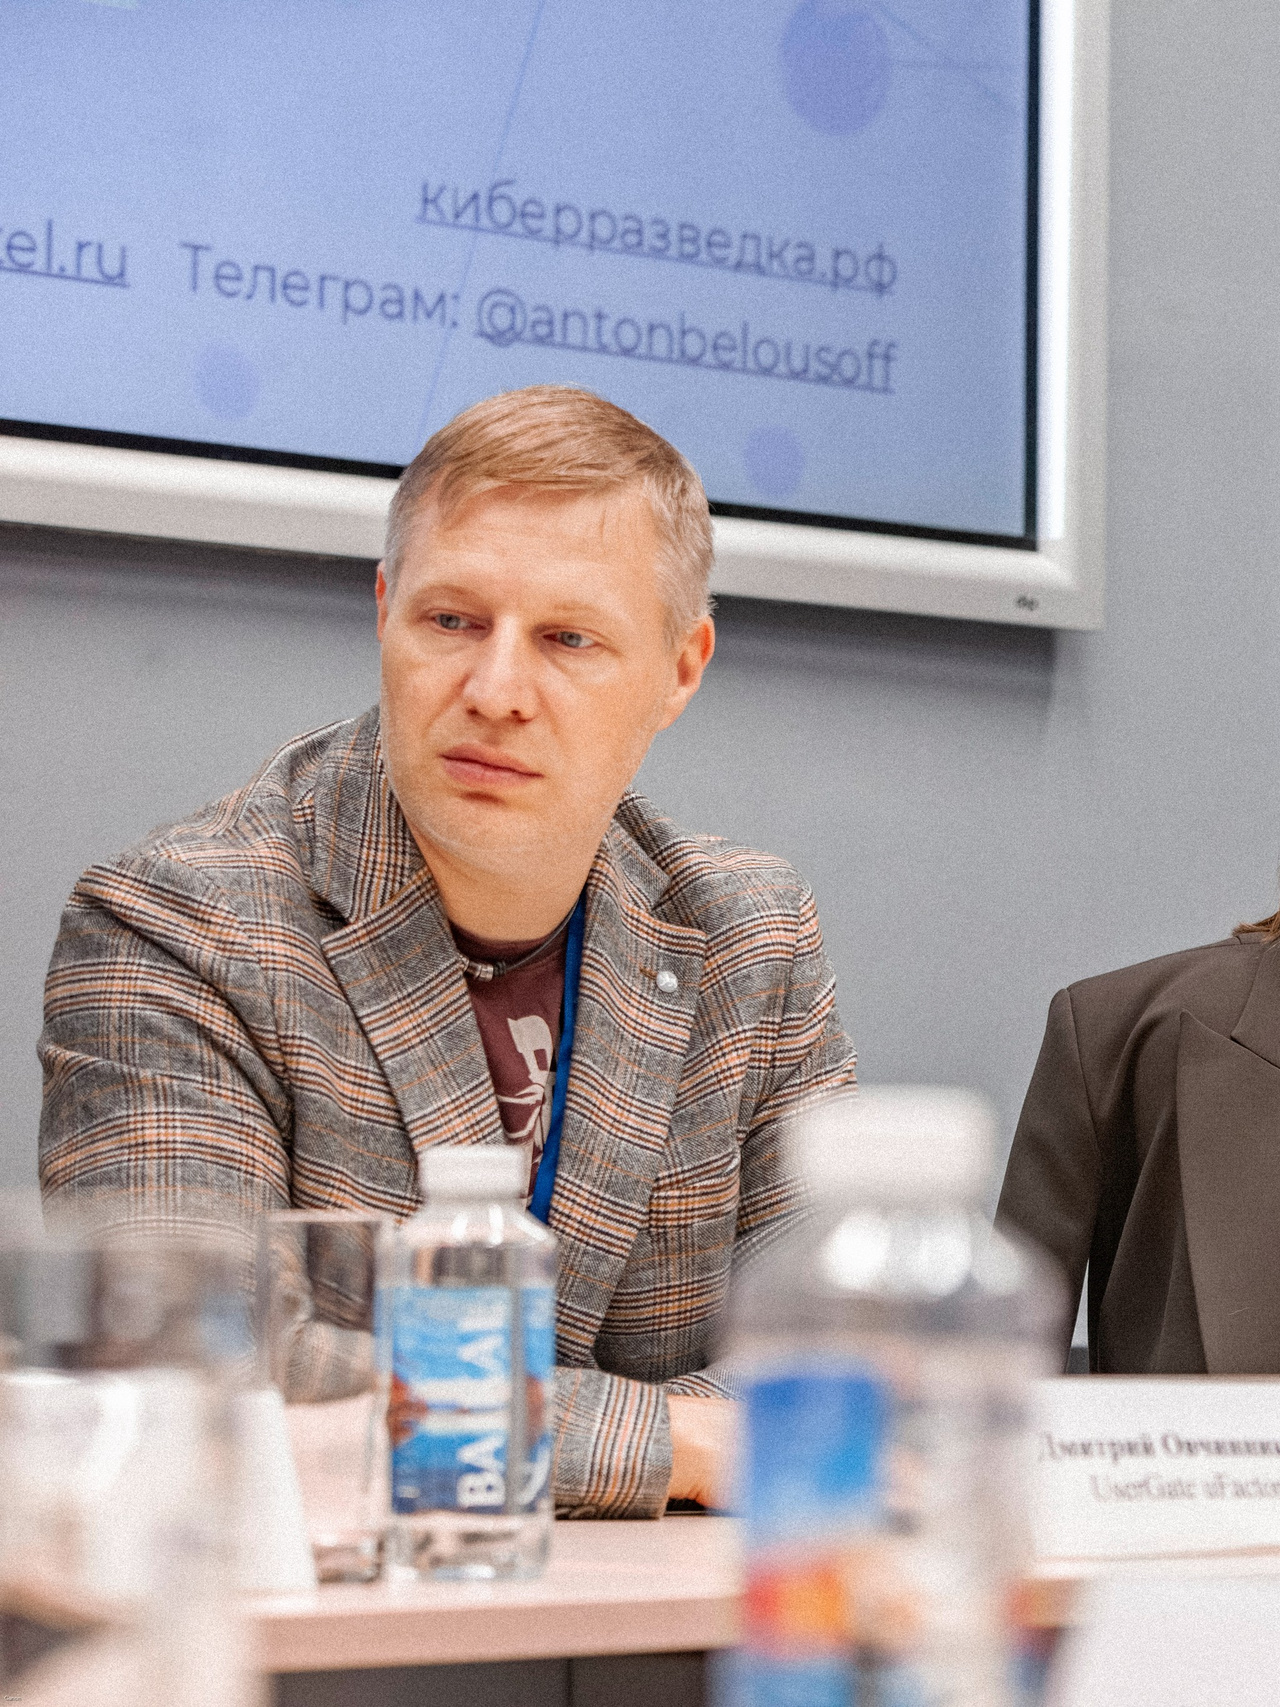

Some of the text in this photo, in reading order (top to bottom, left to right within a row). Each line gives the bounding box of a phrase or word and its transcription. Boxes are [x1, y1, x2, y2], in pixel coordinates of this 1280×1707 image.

[0, 217, 128, 287] el.ru
[416, 180, 899, 297] киберразведка.рф
[180, 242, 898, 393] Телеграм: @antonbelousoff
